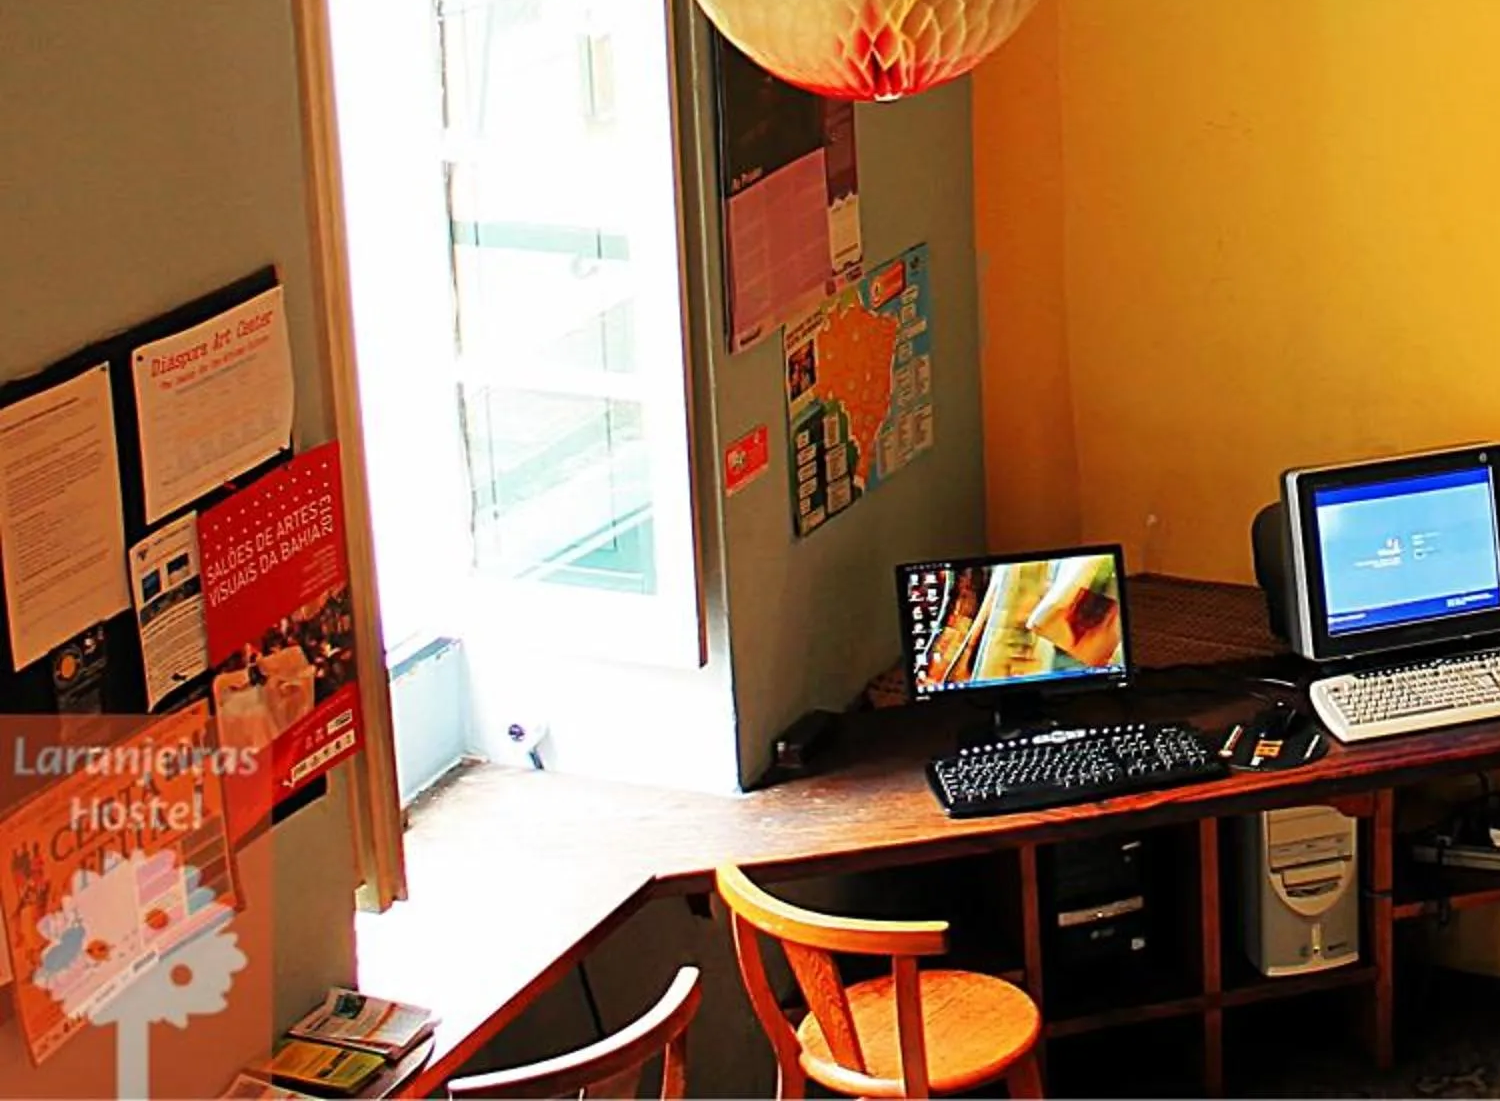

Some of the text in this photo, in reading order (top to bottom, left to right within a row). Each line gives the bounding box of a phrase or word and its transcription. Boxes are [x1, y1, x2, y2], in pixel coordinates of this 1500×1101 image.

[212, 328, 231, 351] Art
[207, 540, 253, 586] SALÕES
[255, 526, 275, 552] DE
[276, 500, 319, 540] ARTES
[319, 494, 333, 536] 2013
[207, 562, 258, 608] VISUAIS
[259, 550, 279, 574] DA
[280, 523, 321, 562] BAHIA
